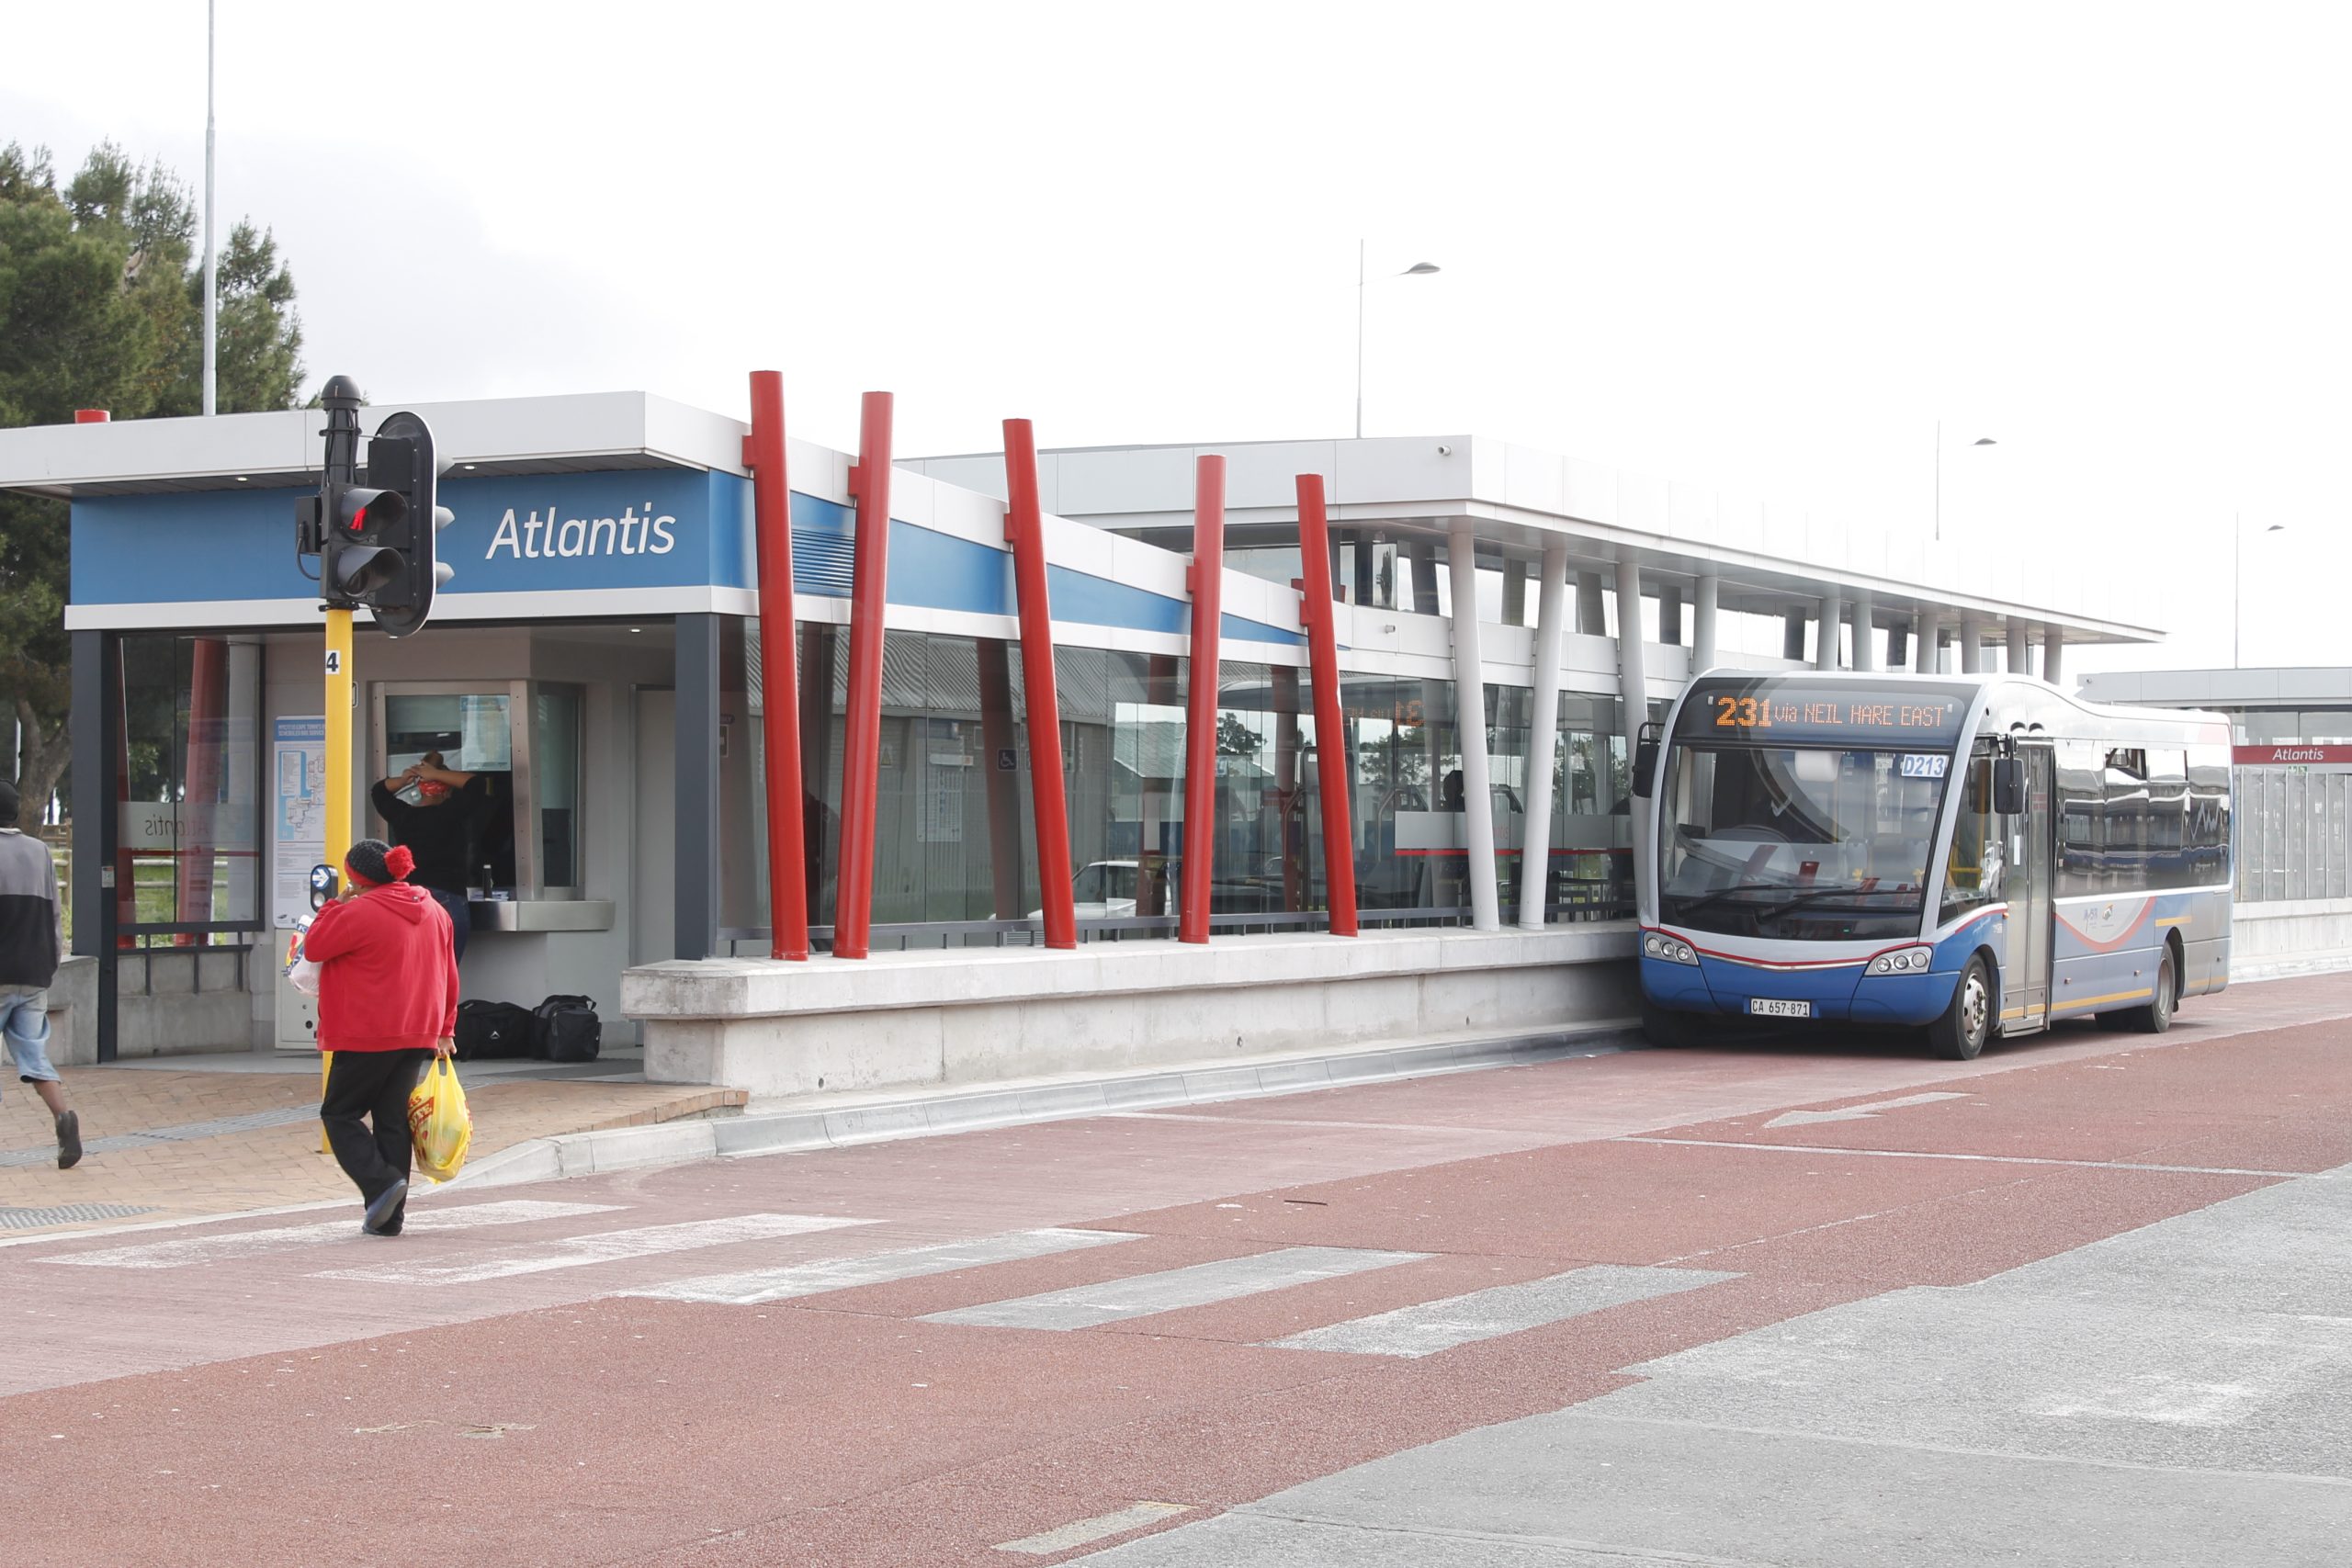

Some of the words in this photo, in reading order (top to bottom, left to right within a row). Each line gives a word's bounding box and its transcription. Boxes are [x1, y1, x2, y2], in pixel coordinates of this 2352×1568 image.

[485, 502, 676, 559] Atlantis
[326, 652, 339, 672] 4
[1716, 695, 1772, 727] 231
[1774, 702, 1798, 723] via
[1804, 703, 1843, 724] NEIL
[1850, 705, 1894, 726] HARE
[1901, 705, 1945, 728] EAST
[2272, 748, 2324, 761] Atlantis
[1903, 756, 1944, 776] D213
[1752, 1000, 1764, 1013] CA
